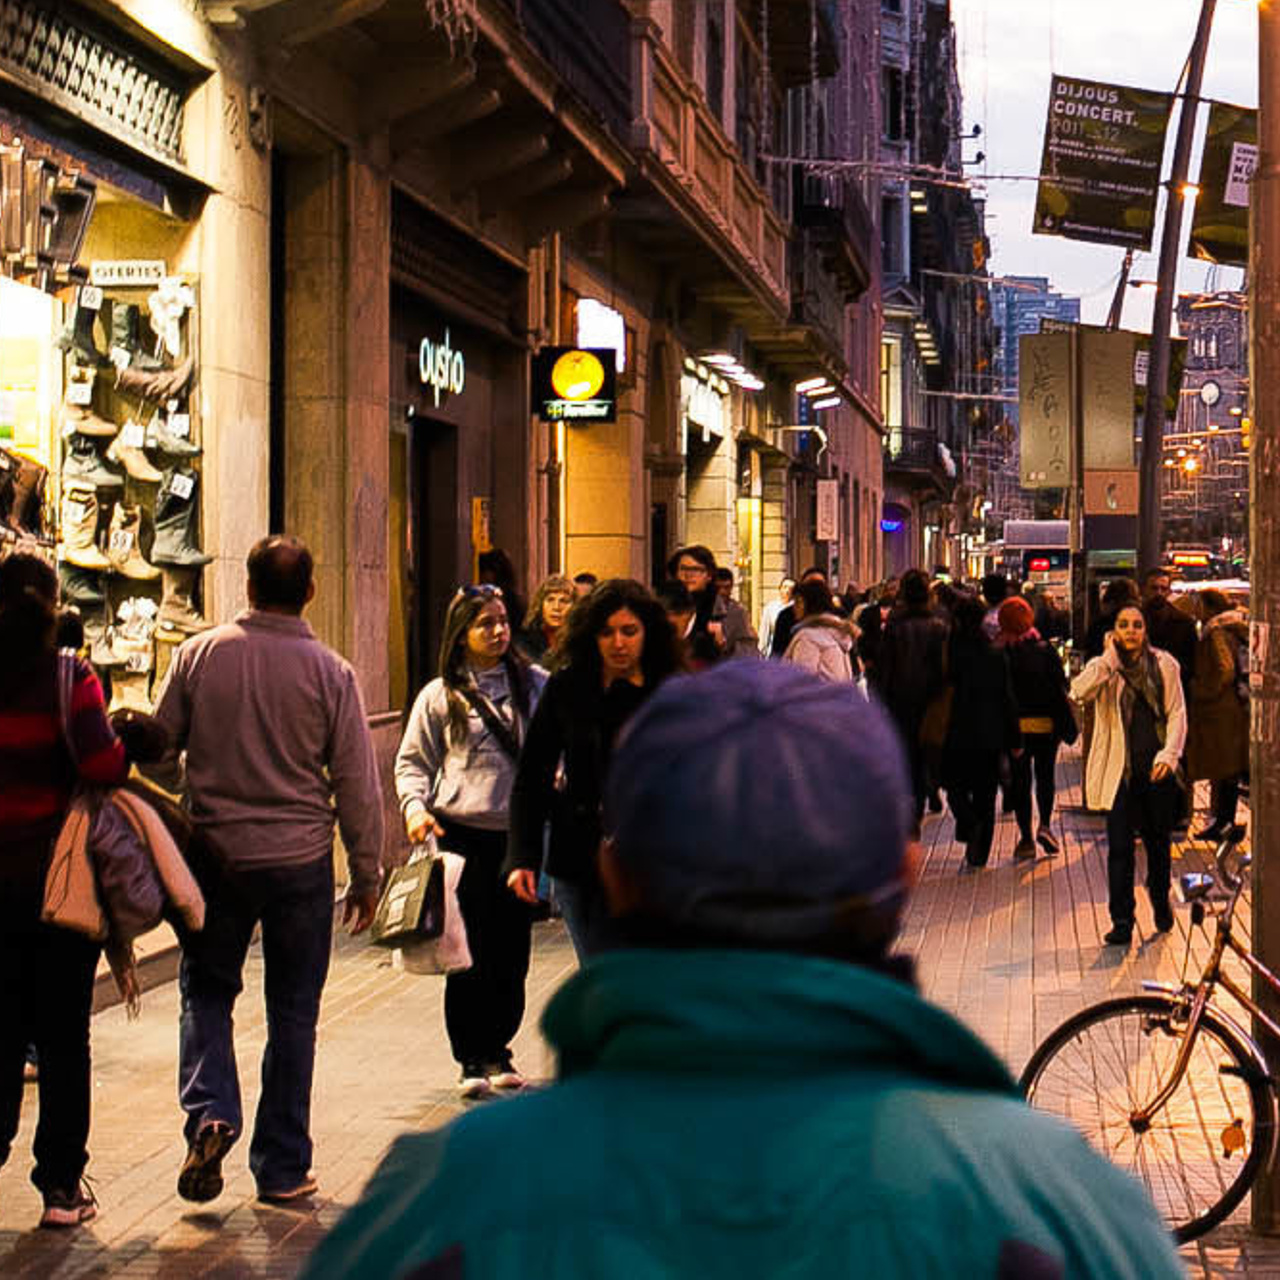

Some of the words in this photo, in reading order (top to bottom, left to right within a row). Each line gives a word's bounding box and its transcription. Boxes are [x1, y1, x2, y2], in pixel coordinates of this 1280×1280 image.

[1056, 82, 1119, 104] DIJOUS
[1053, 100, 1139, 127] CONCERT.
[419, 327, 465, 408] oysho
